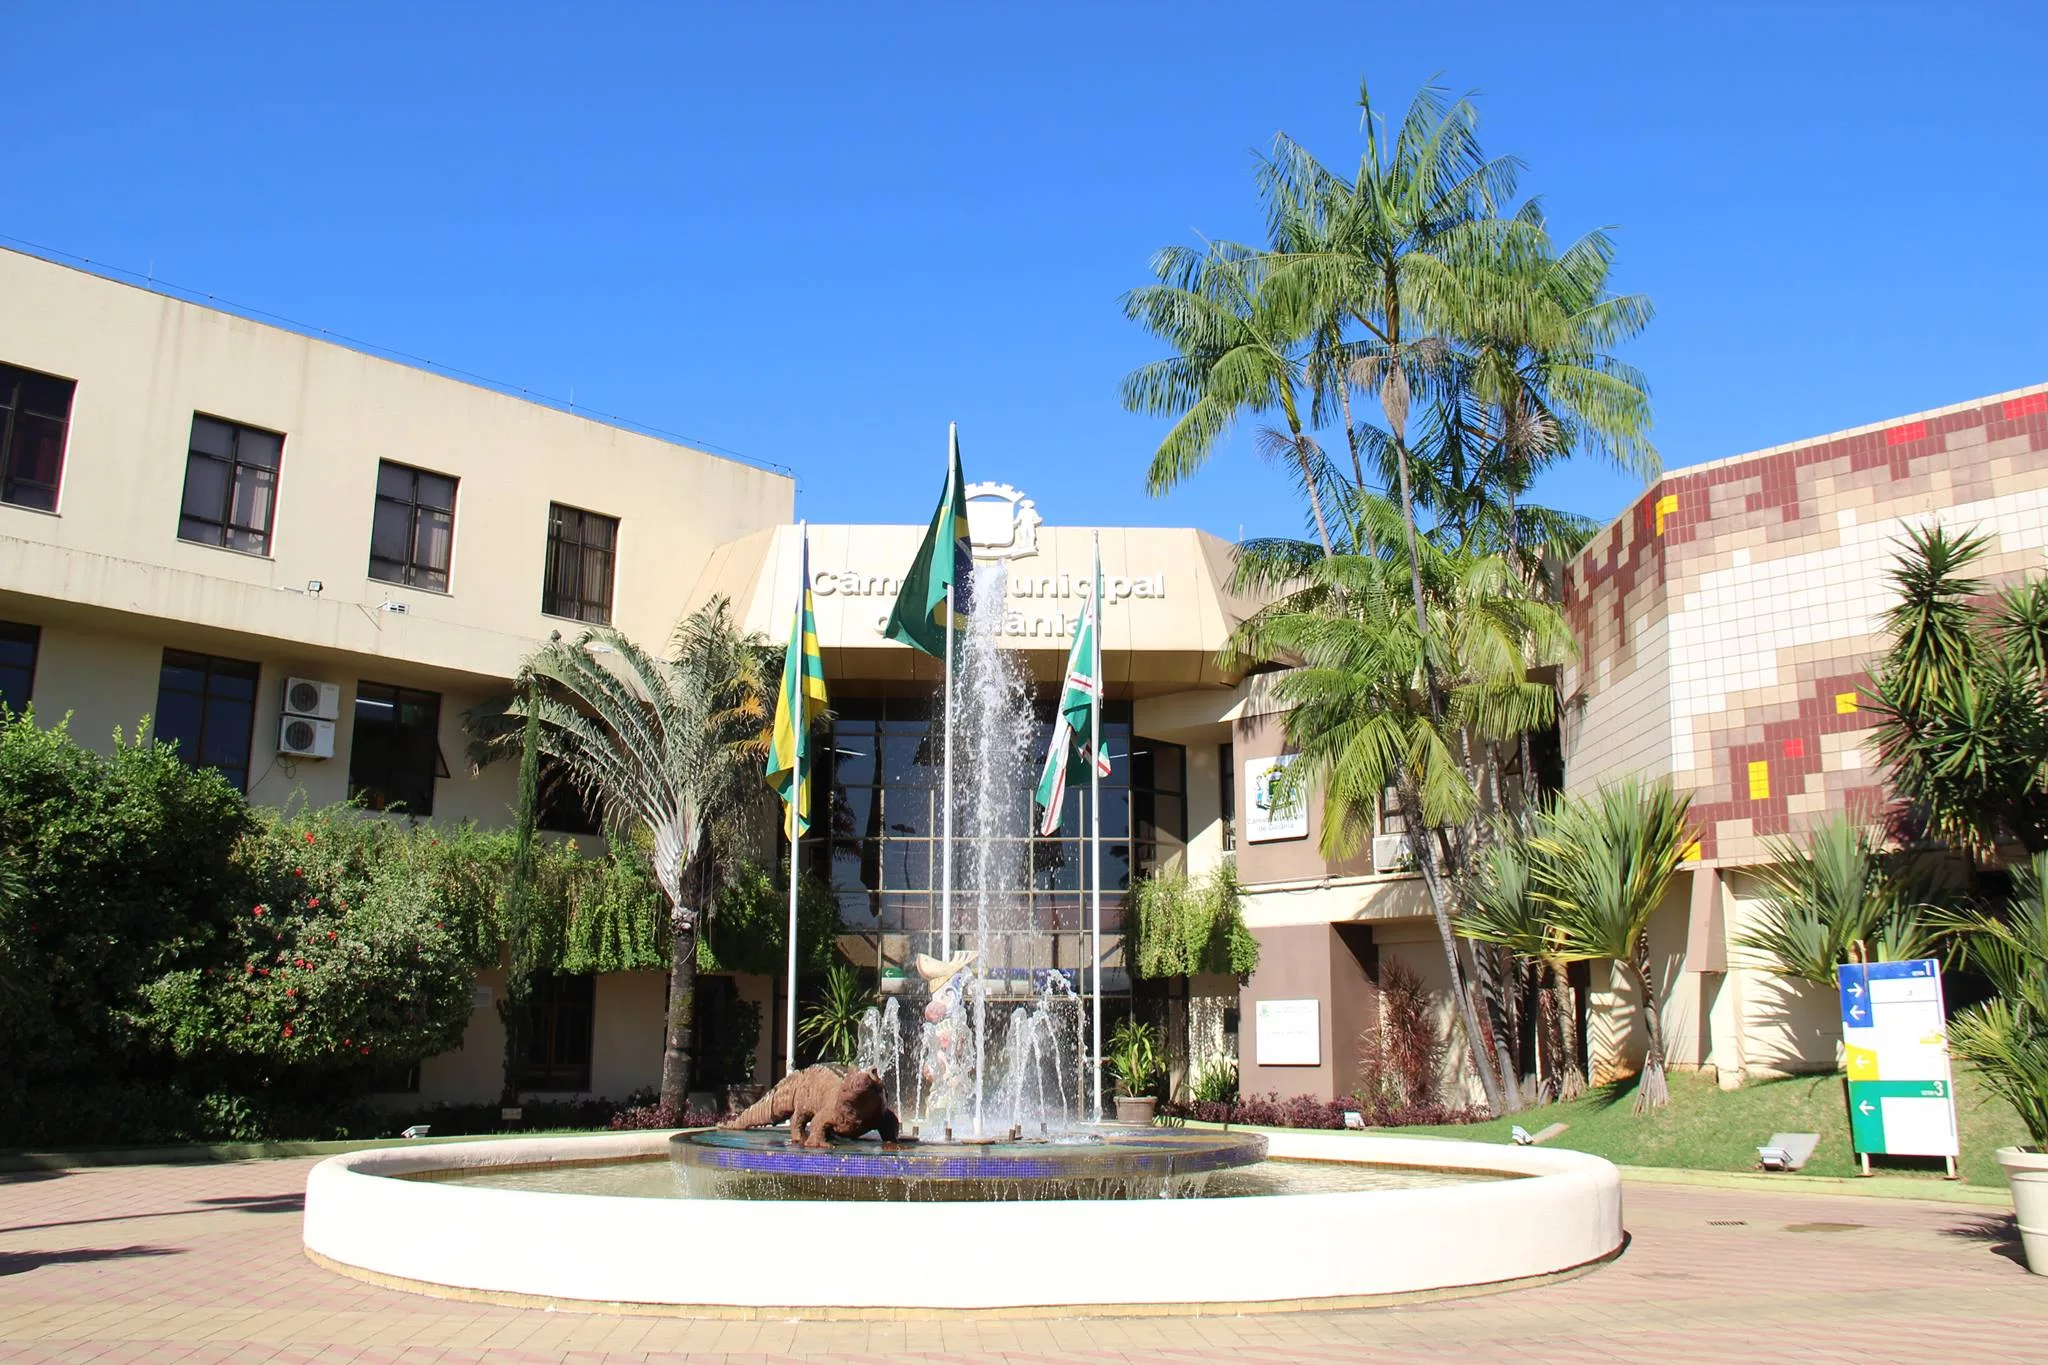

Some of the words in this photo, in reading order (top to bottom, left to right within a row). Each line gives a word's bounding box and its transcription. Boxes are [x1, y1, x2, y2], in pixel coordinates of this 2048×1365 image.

[812, 570, 904, 597] Câm
[1002, 570, 1166, 605] unicpal
[995, 606, 1080, 638] ânia
[1932, 1081, 1944, 1097] 3
